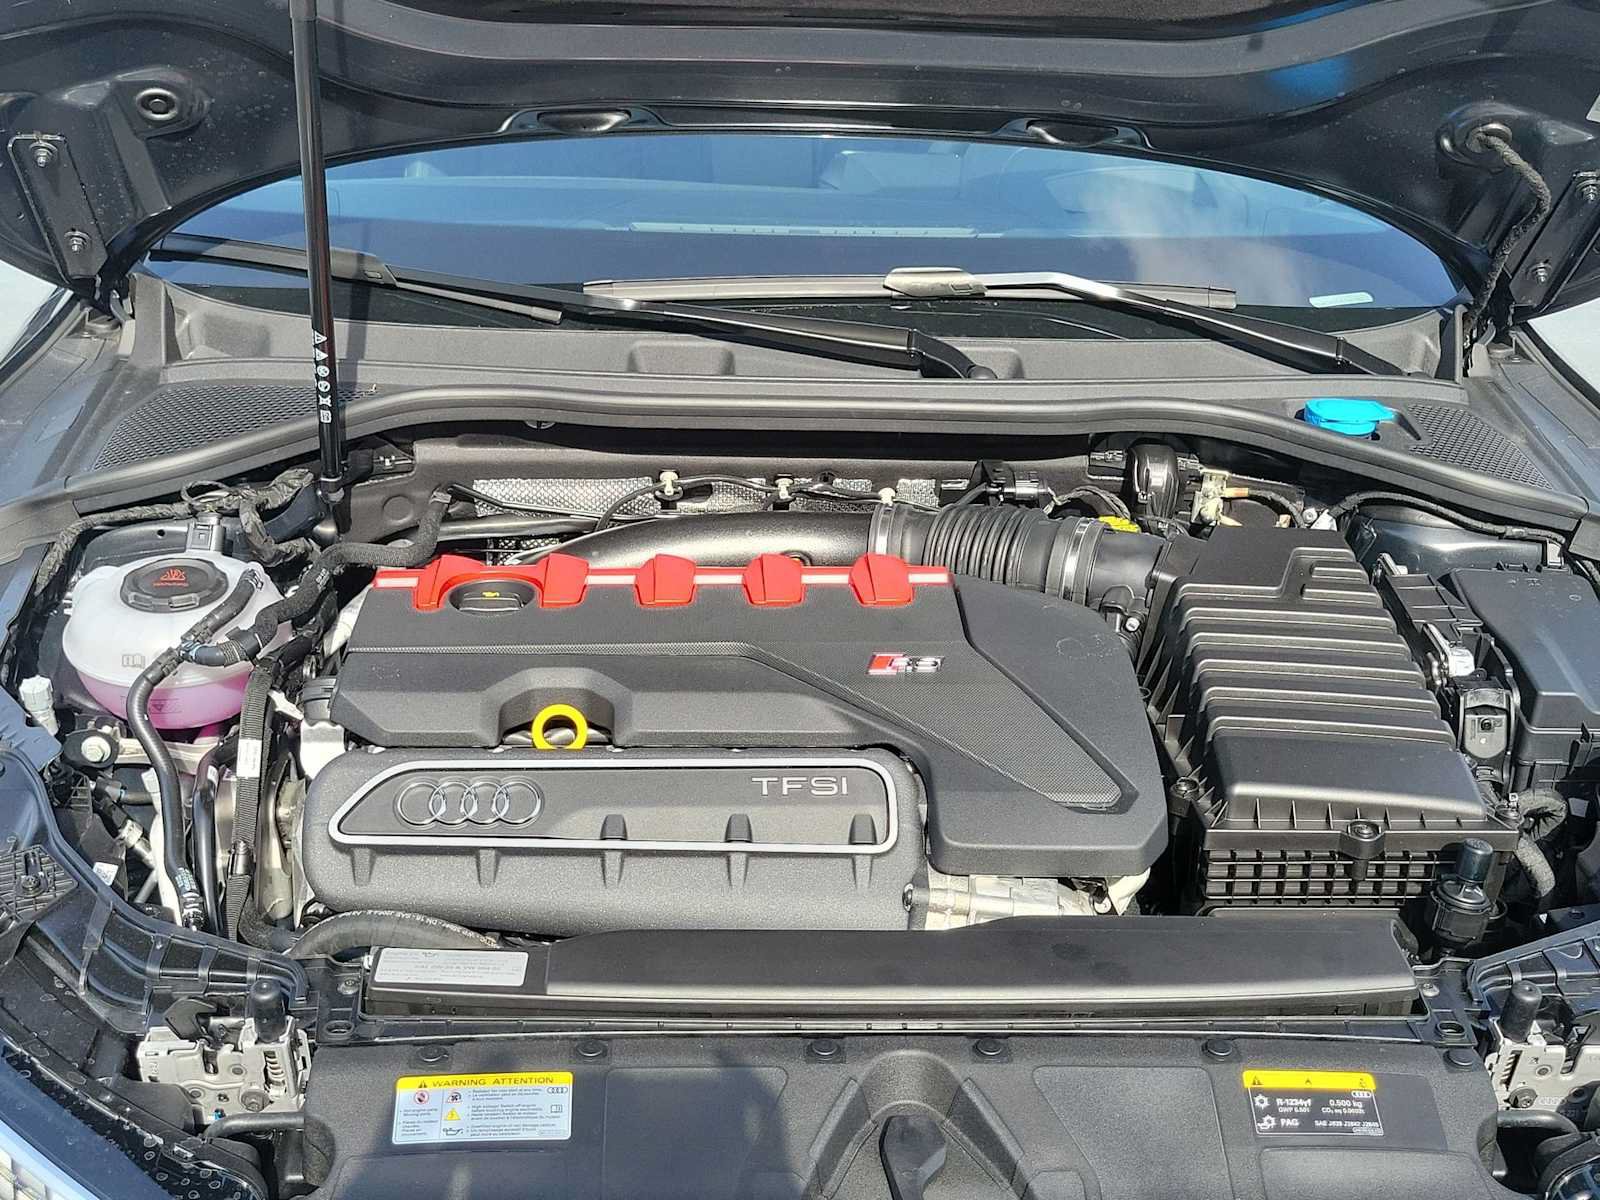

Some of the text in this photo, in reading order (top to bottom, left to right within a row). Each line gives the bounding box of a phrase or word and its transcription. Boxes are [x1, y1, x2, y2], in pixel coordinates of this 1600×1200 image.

[751, 776, 848, 796] TFSI
[432, 1076, 554, 1088] WARNING ATTENTION
[1329, 1099, 1352, 1108] 0.500
[1280, 1118, 1300, 1128] PAG
